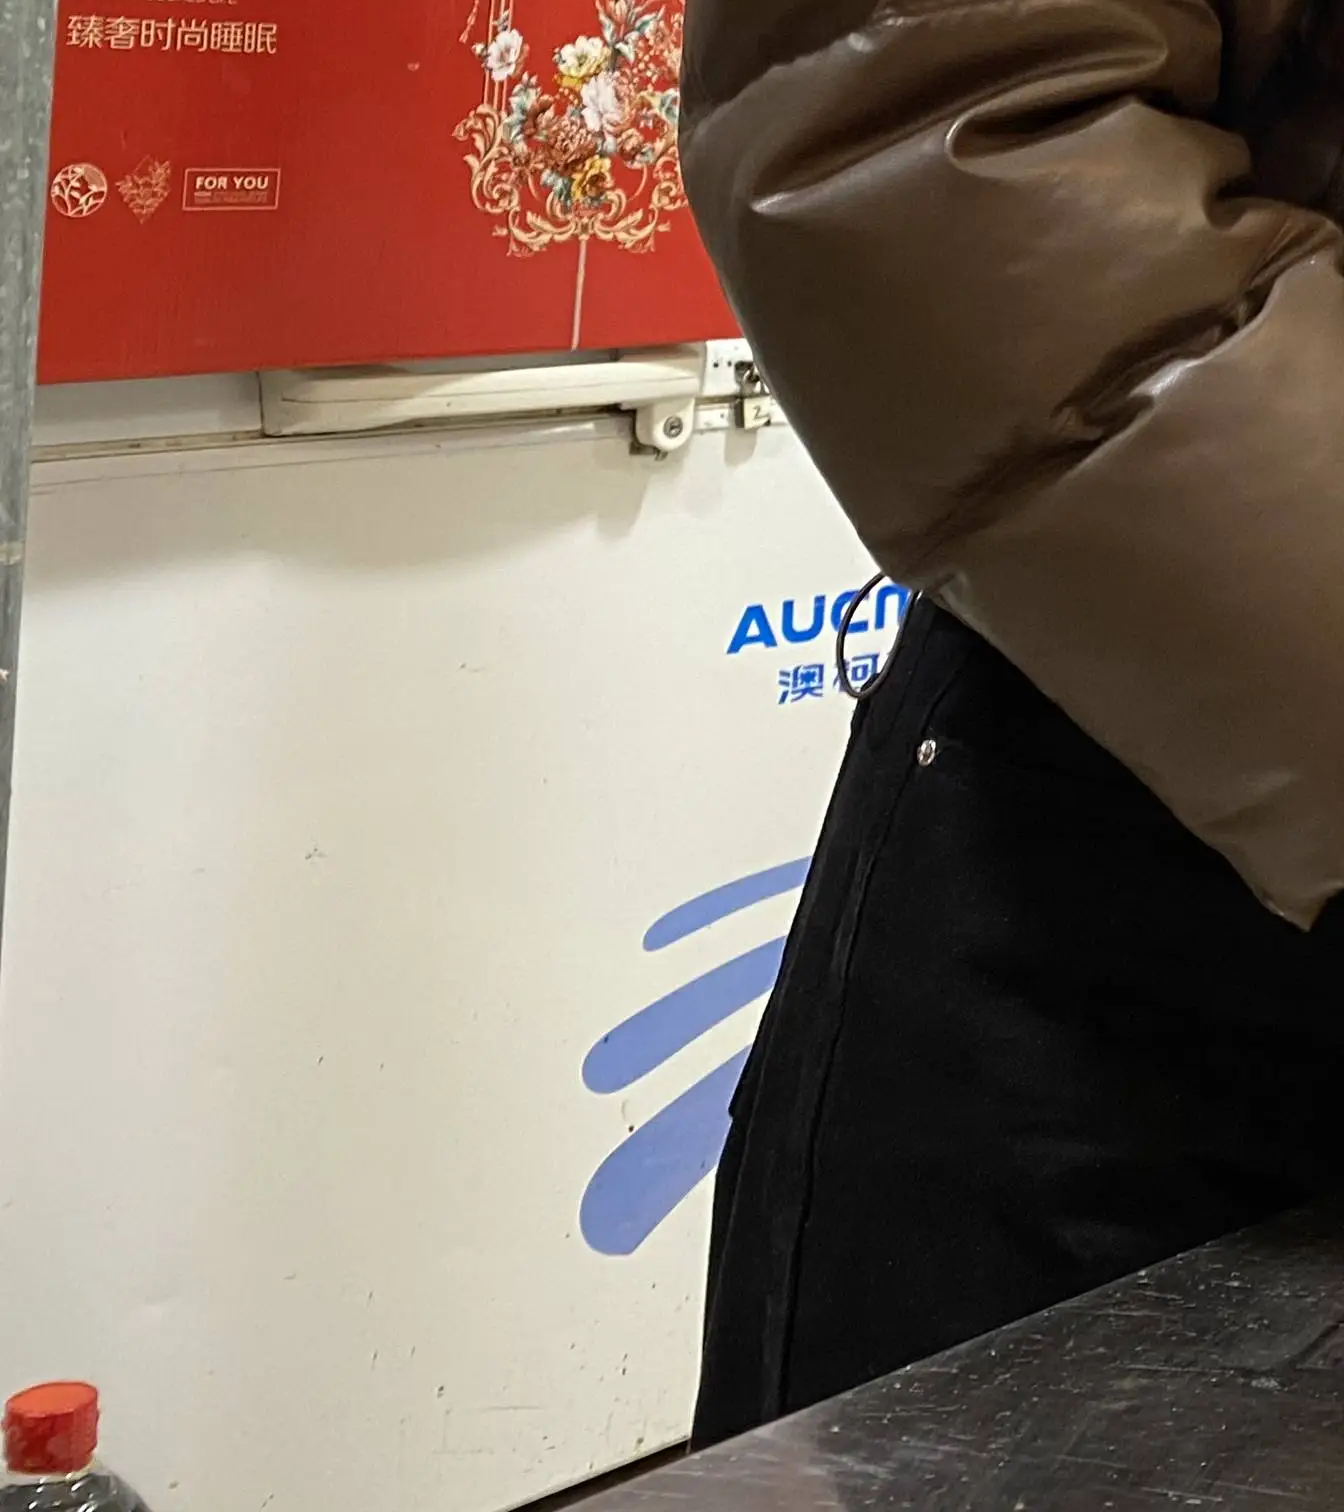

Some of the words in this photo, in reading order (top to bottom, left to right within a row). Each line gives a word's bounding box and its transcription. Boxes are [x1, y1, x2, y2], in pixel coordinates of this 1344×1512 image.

[66, 15, 279, 55] 臻奢时尚睡眠
[195, 175, 229, 190] FOR
[232, 175, 269, 190] YOU
